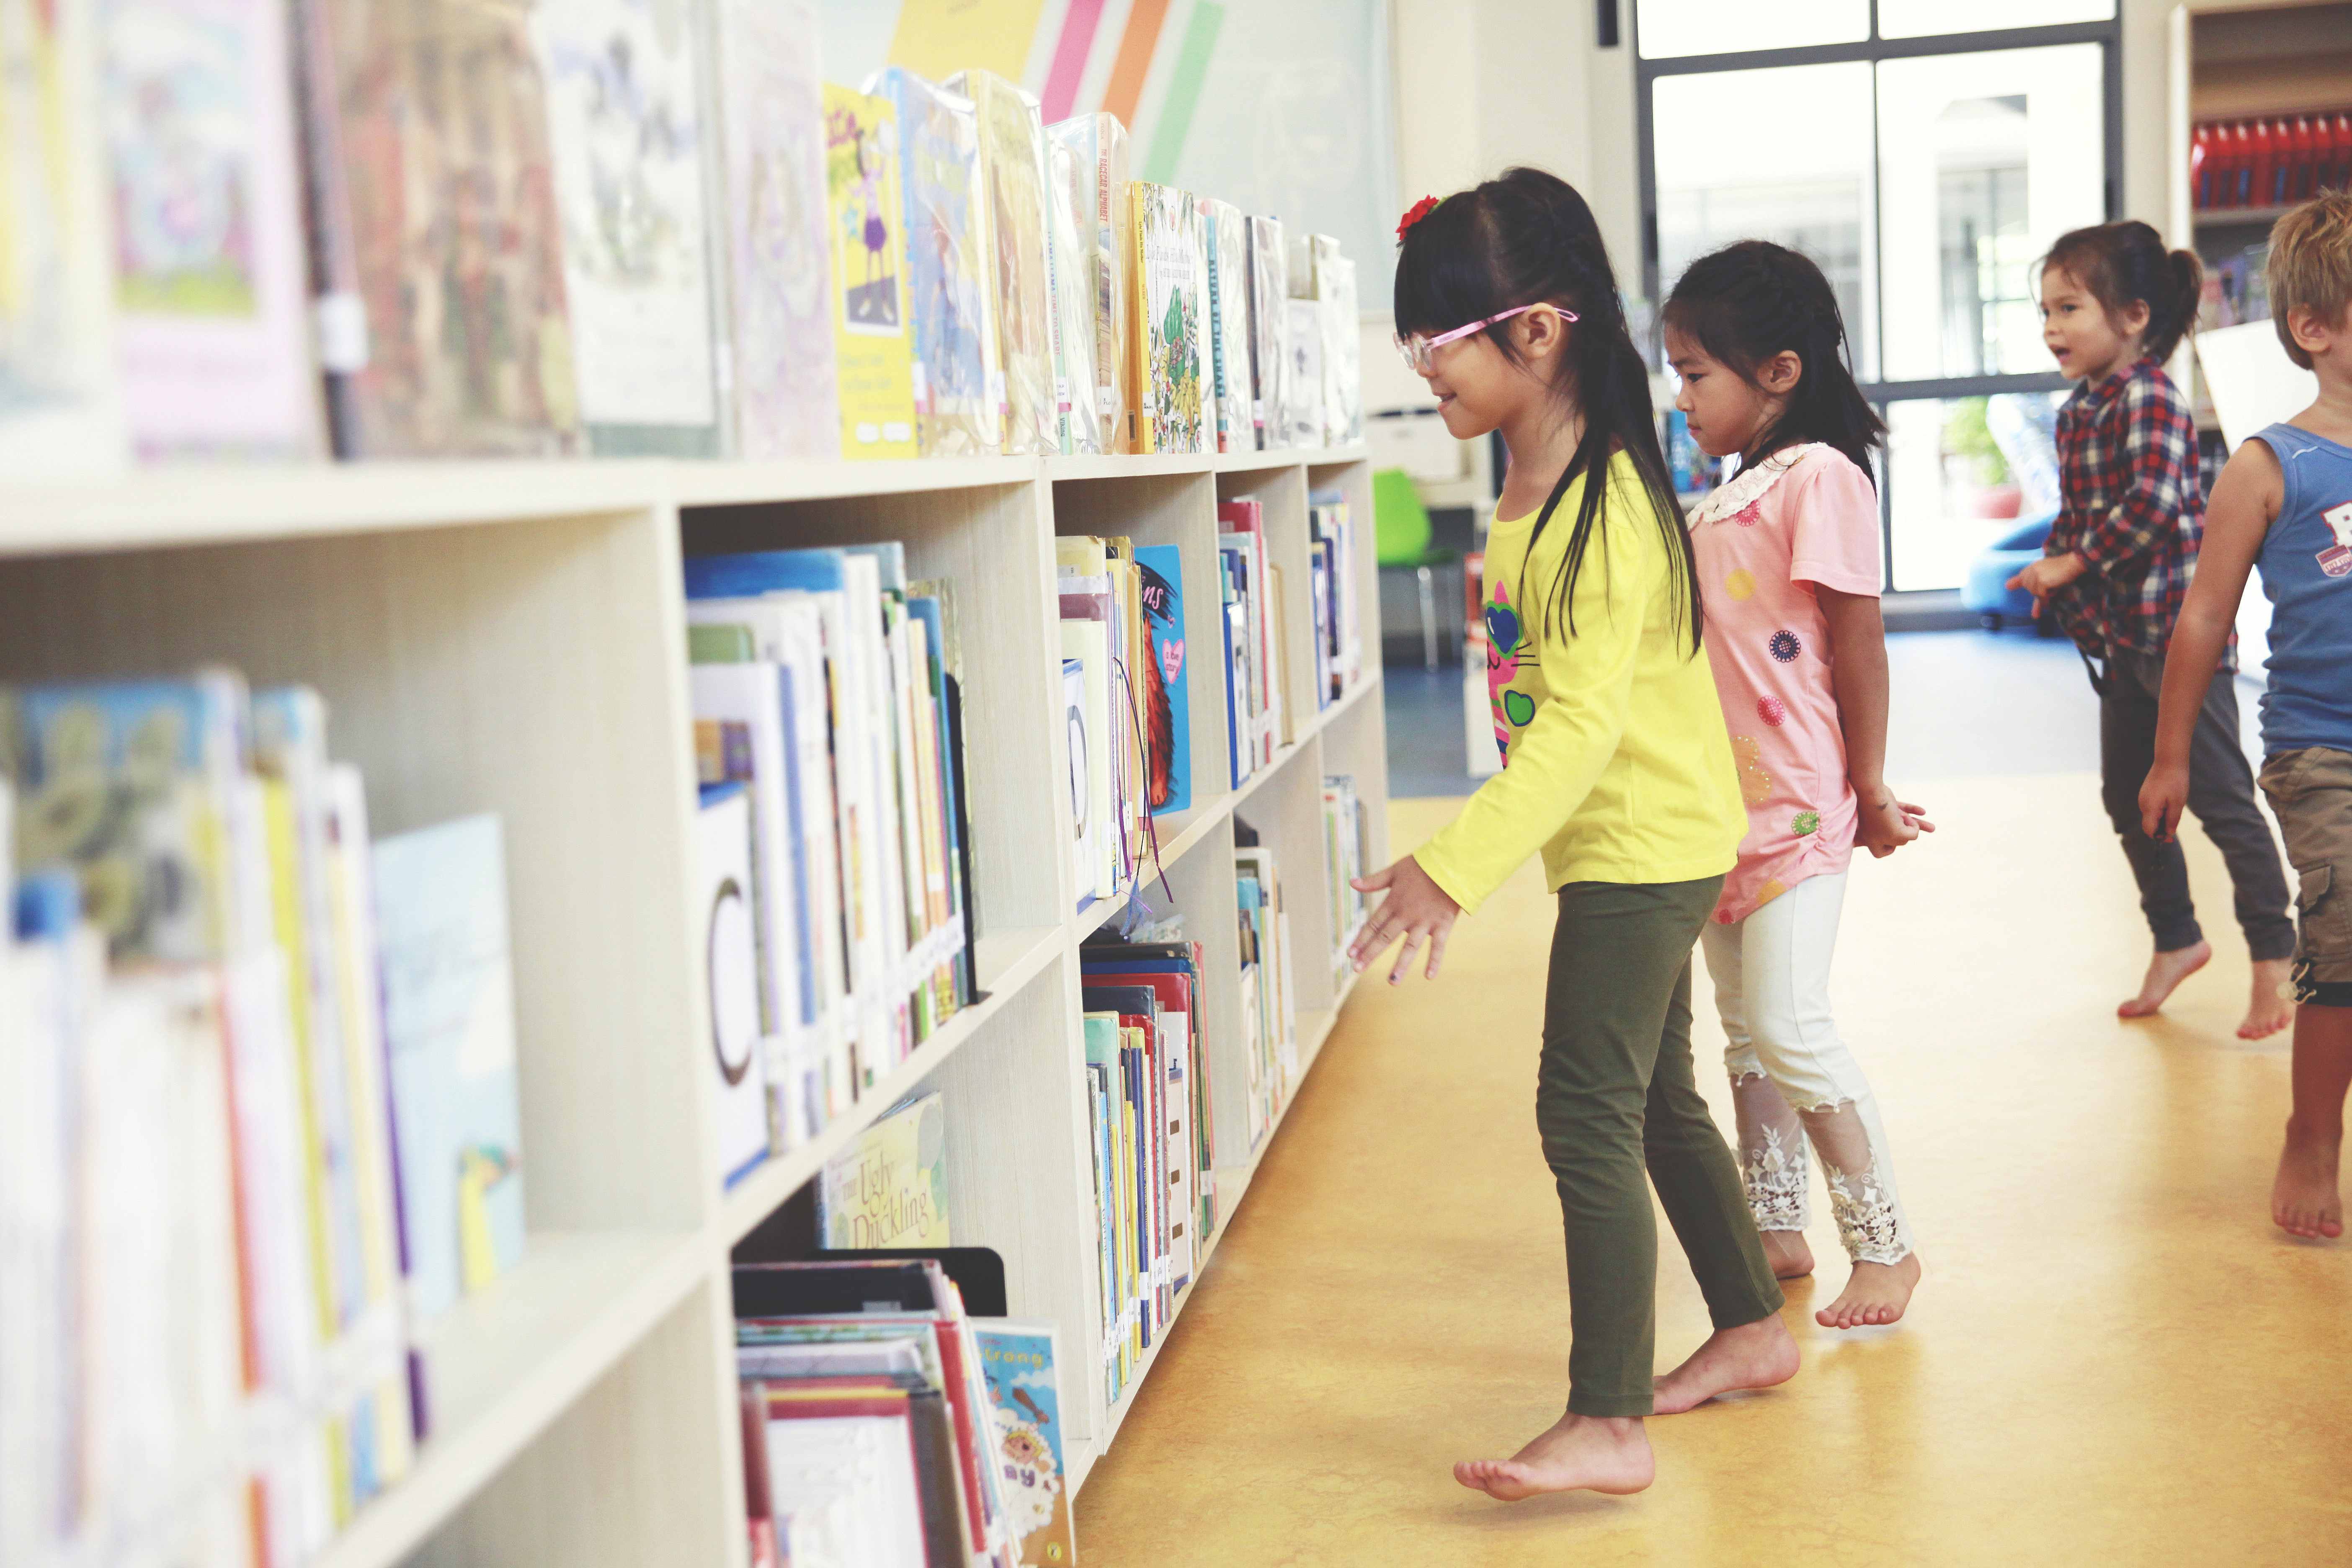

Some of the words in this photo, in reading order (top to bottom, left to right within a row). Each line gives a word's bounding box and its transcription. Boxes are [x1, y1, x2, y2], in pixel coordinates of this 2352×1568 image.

[1099, 157, 1108, 188] RACECAR
[1099, 188, 1108, 222] ALPHABET
[707, 877, 753, 1086] C
[860, 1150, 895, 1218] Ugly
[853, 1185, 930, 1249] Duckling
